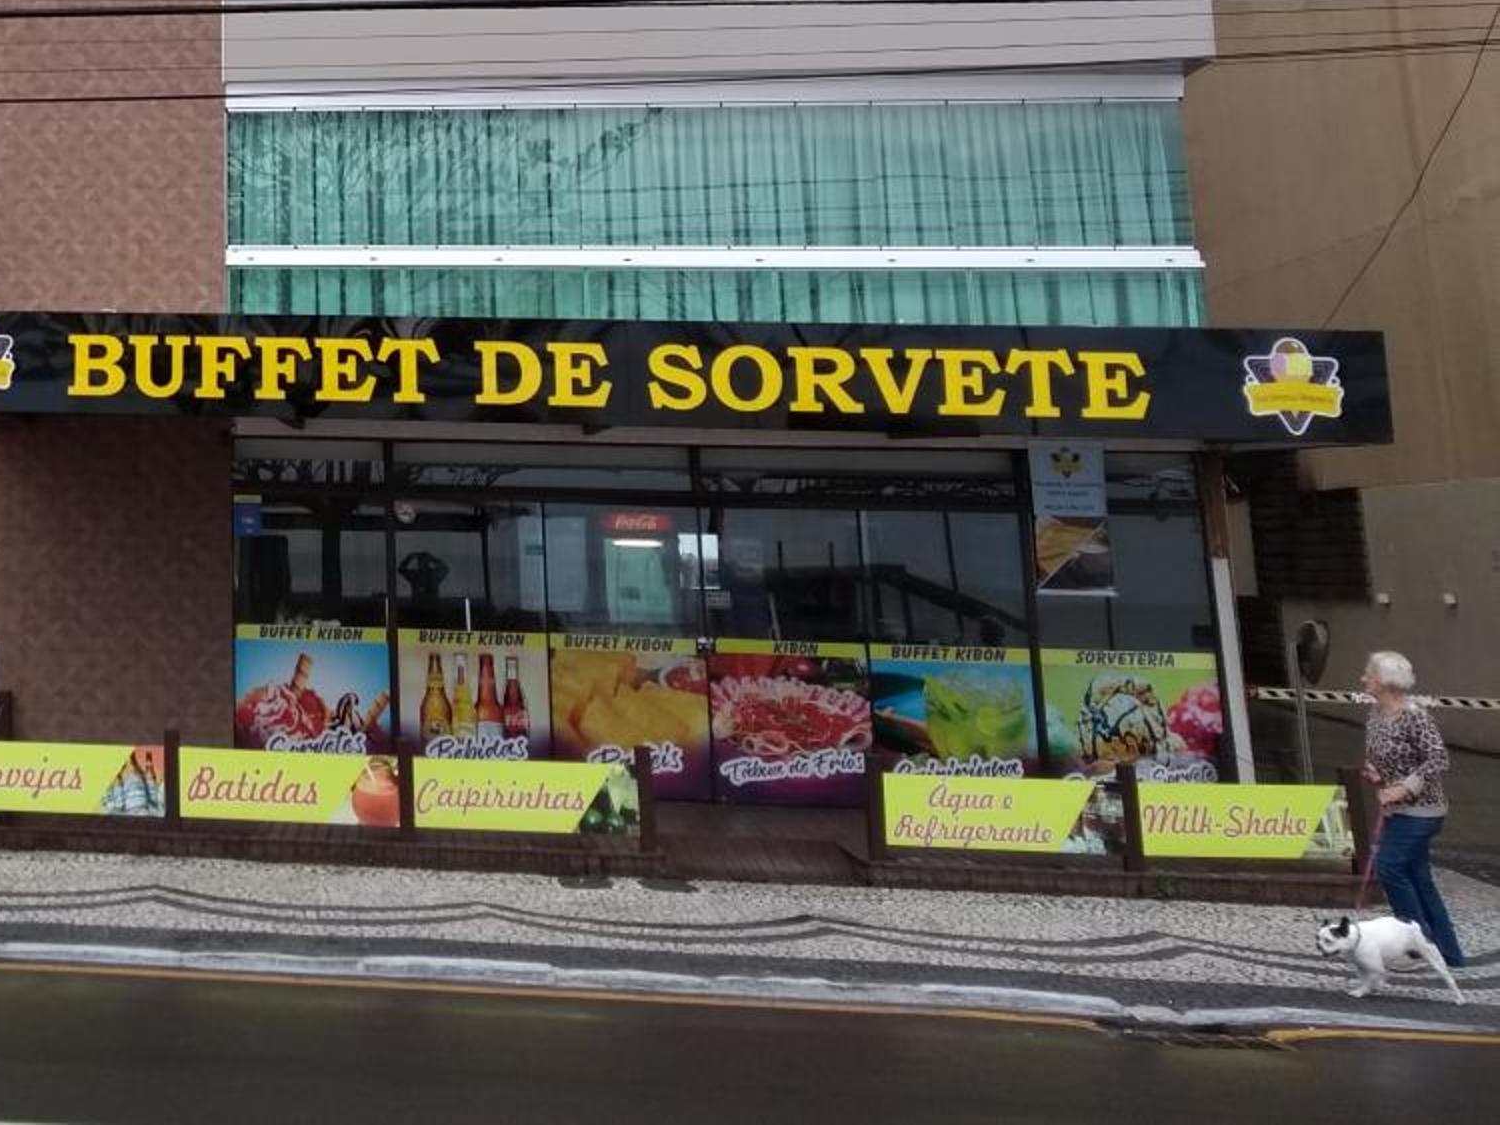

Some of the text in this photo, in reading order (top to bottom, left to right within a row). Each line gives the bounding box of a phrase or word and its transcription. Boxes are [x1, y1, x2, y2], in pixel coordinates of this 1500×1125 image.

[67, 334, 1151, 419] BUFFET DE SORVETE
[259, 626, 363, 642] BUFFET KIBON
[419, 630, 525, 646] BUFFET KIBON
[564, 635, 673, 652] BUFFET KIBON
[773, 641, 819, 656] KIBON
[891, 646, 1007, 663] BUFFET KIBON
[1075, 650, 1176, 668] SORVETERIA
[187, 766, 318, 806] Batidas
[416, 778, 585, 815] Caipirinhas
[1003, 793, 1013, 810] e
[1142, 803, 1308, 838] Milk-Shake
[893, 814, 1052, 849] Refrigerante
